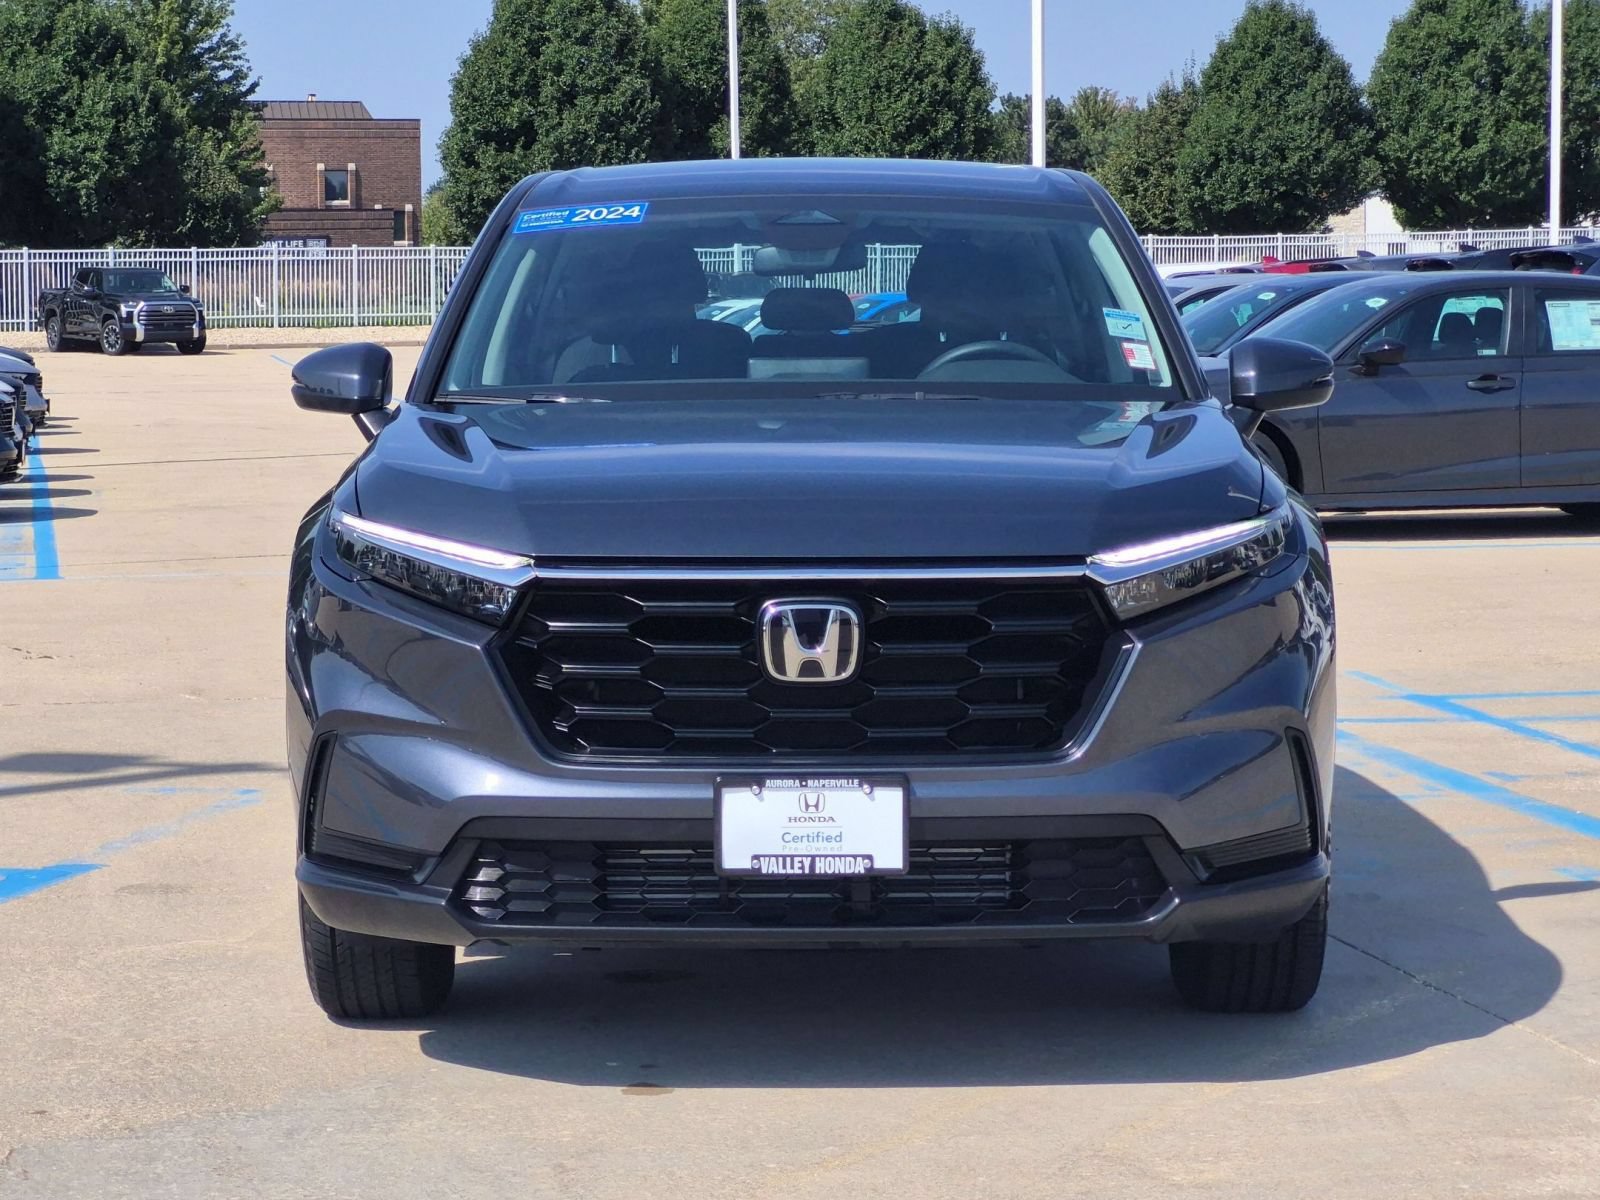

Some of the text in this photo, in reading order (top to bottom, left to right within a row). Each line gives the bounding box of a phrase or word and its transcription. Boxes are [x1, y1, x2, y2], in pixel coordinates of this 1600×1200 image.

[571, 205, 641, 222] 2024
[285, 240, 304, 248] LIFE
[765, 779, 859, 788] AURORA NAPERVILLE
[781, 831, 843, 843] Certified
[760, 857, 865, 874] VALLEY HONDA
